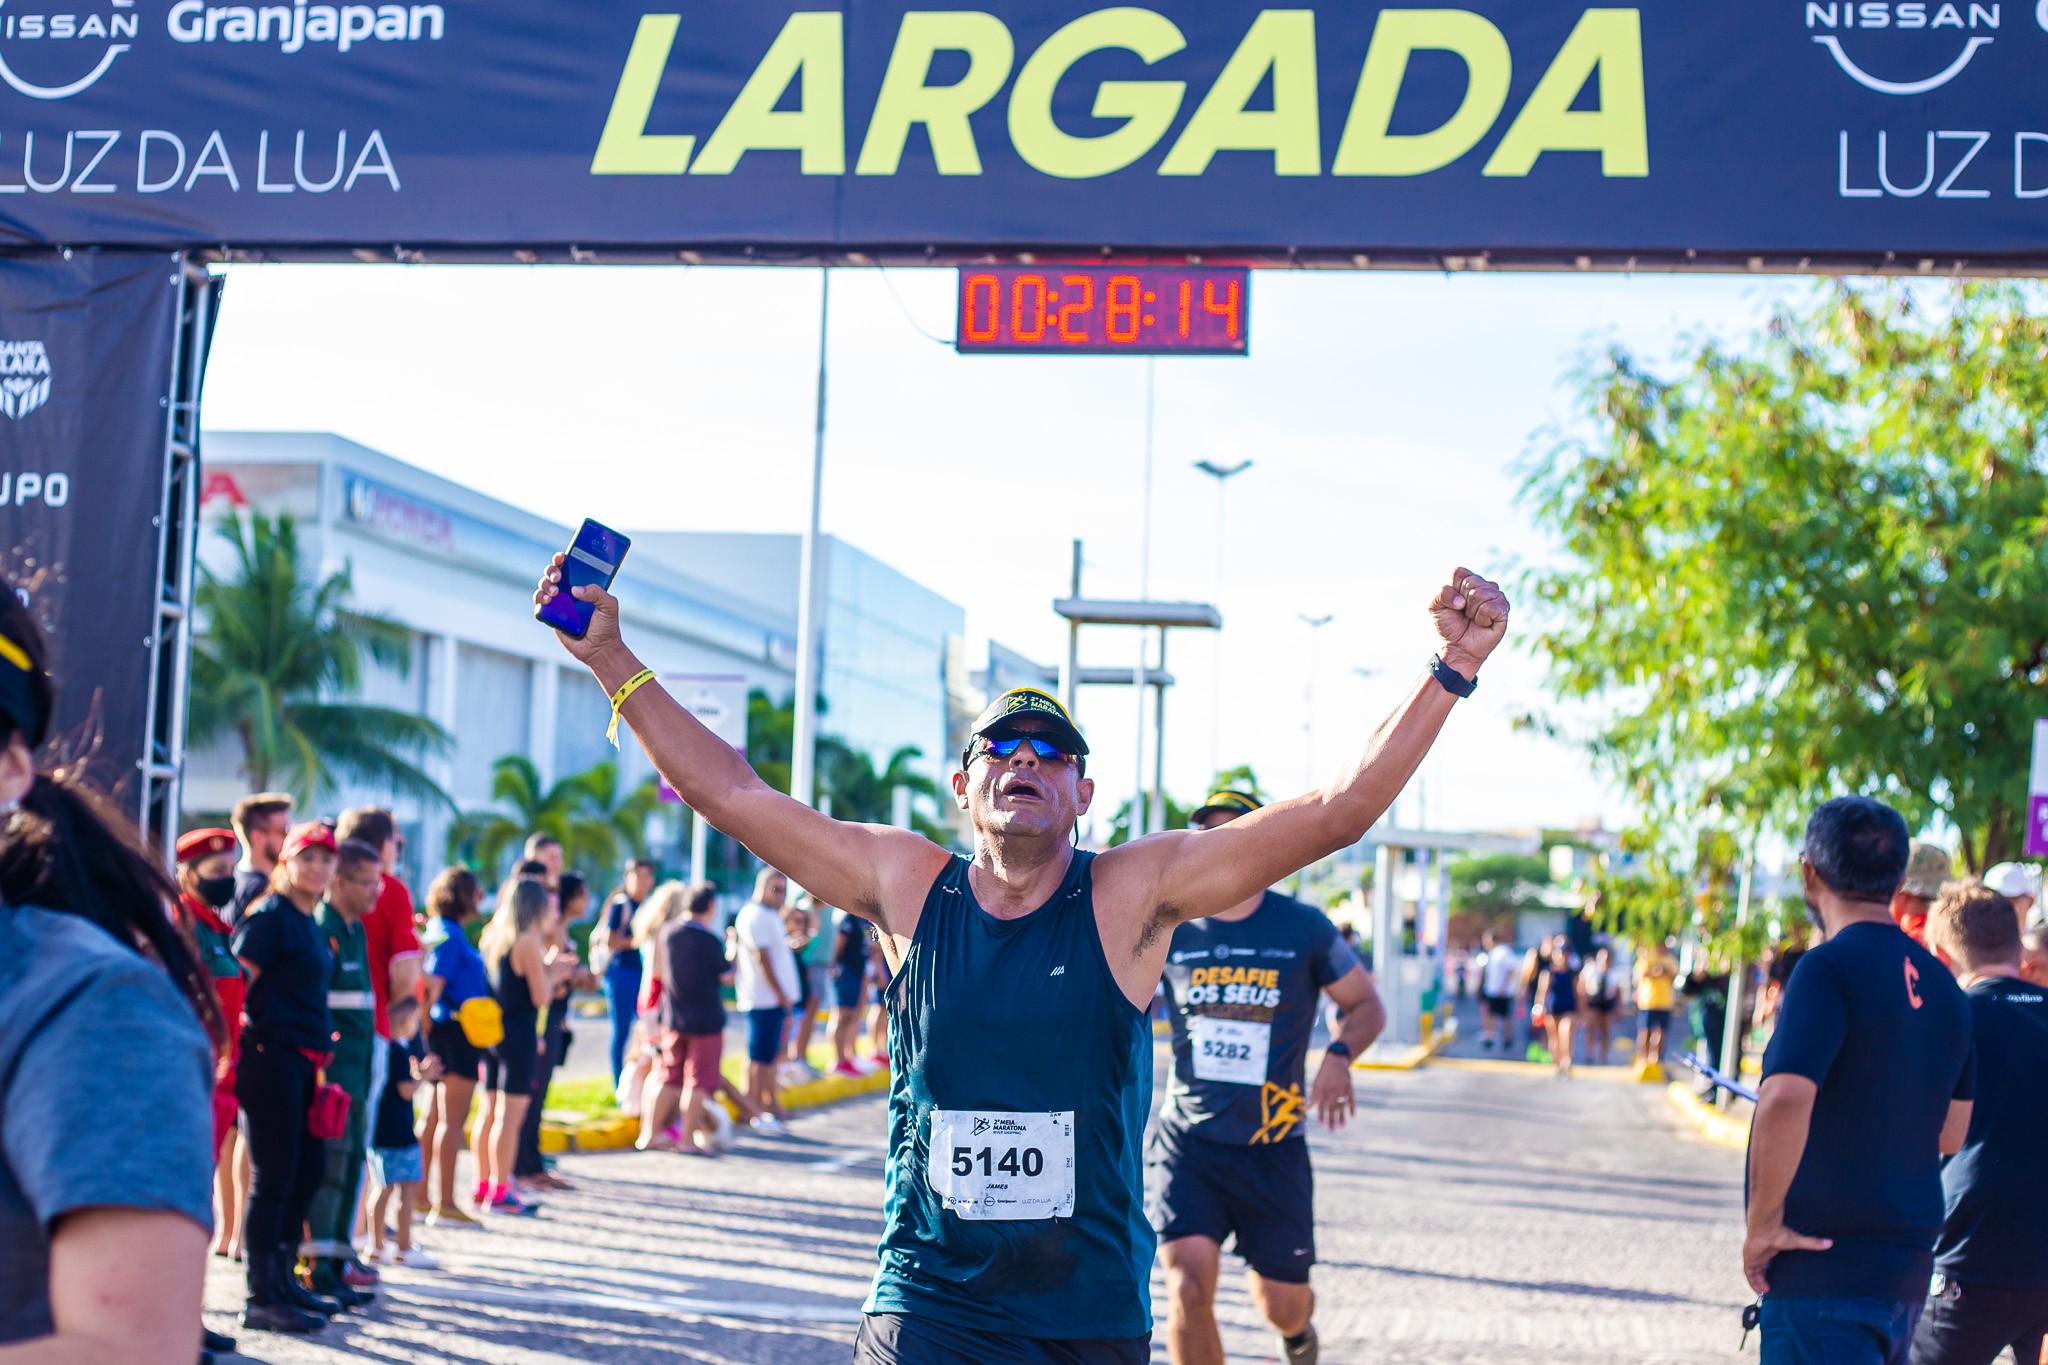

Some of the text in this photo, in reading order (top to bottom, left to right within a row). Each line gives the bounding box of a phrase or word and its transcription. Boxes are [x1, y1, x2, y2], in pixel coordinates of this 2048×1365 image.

[0, 13, 139, 39] ISSAN
[167, 0, 444, 53] Granjapan
[1806, 2, 2001, 29] NISSAN
[591, 7, 1650, 177] LARGADA
[136, 130, 240, 193] DA
[256, 130, 401, 193] LUA
[1839, 130, 1992, 198] LUZ
[963, 273, 1240, 343] 00:28:14
[0, 354, 52, 376] LARA
[1191, 966, 1280, 989] DESAFIE
[1187, 983, 1282, 1008] OS SEUS
[1203, 1039, 1252, 1061] 5282
[952, 1146, 1044, 1177] 5140
